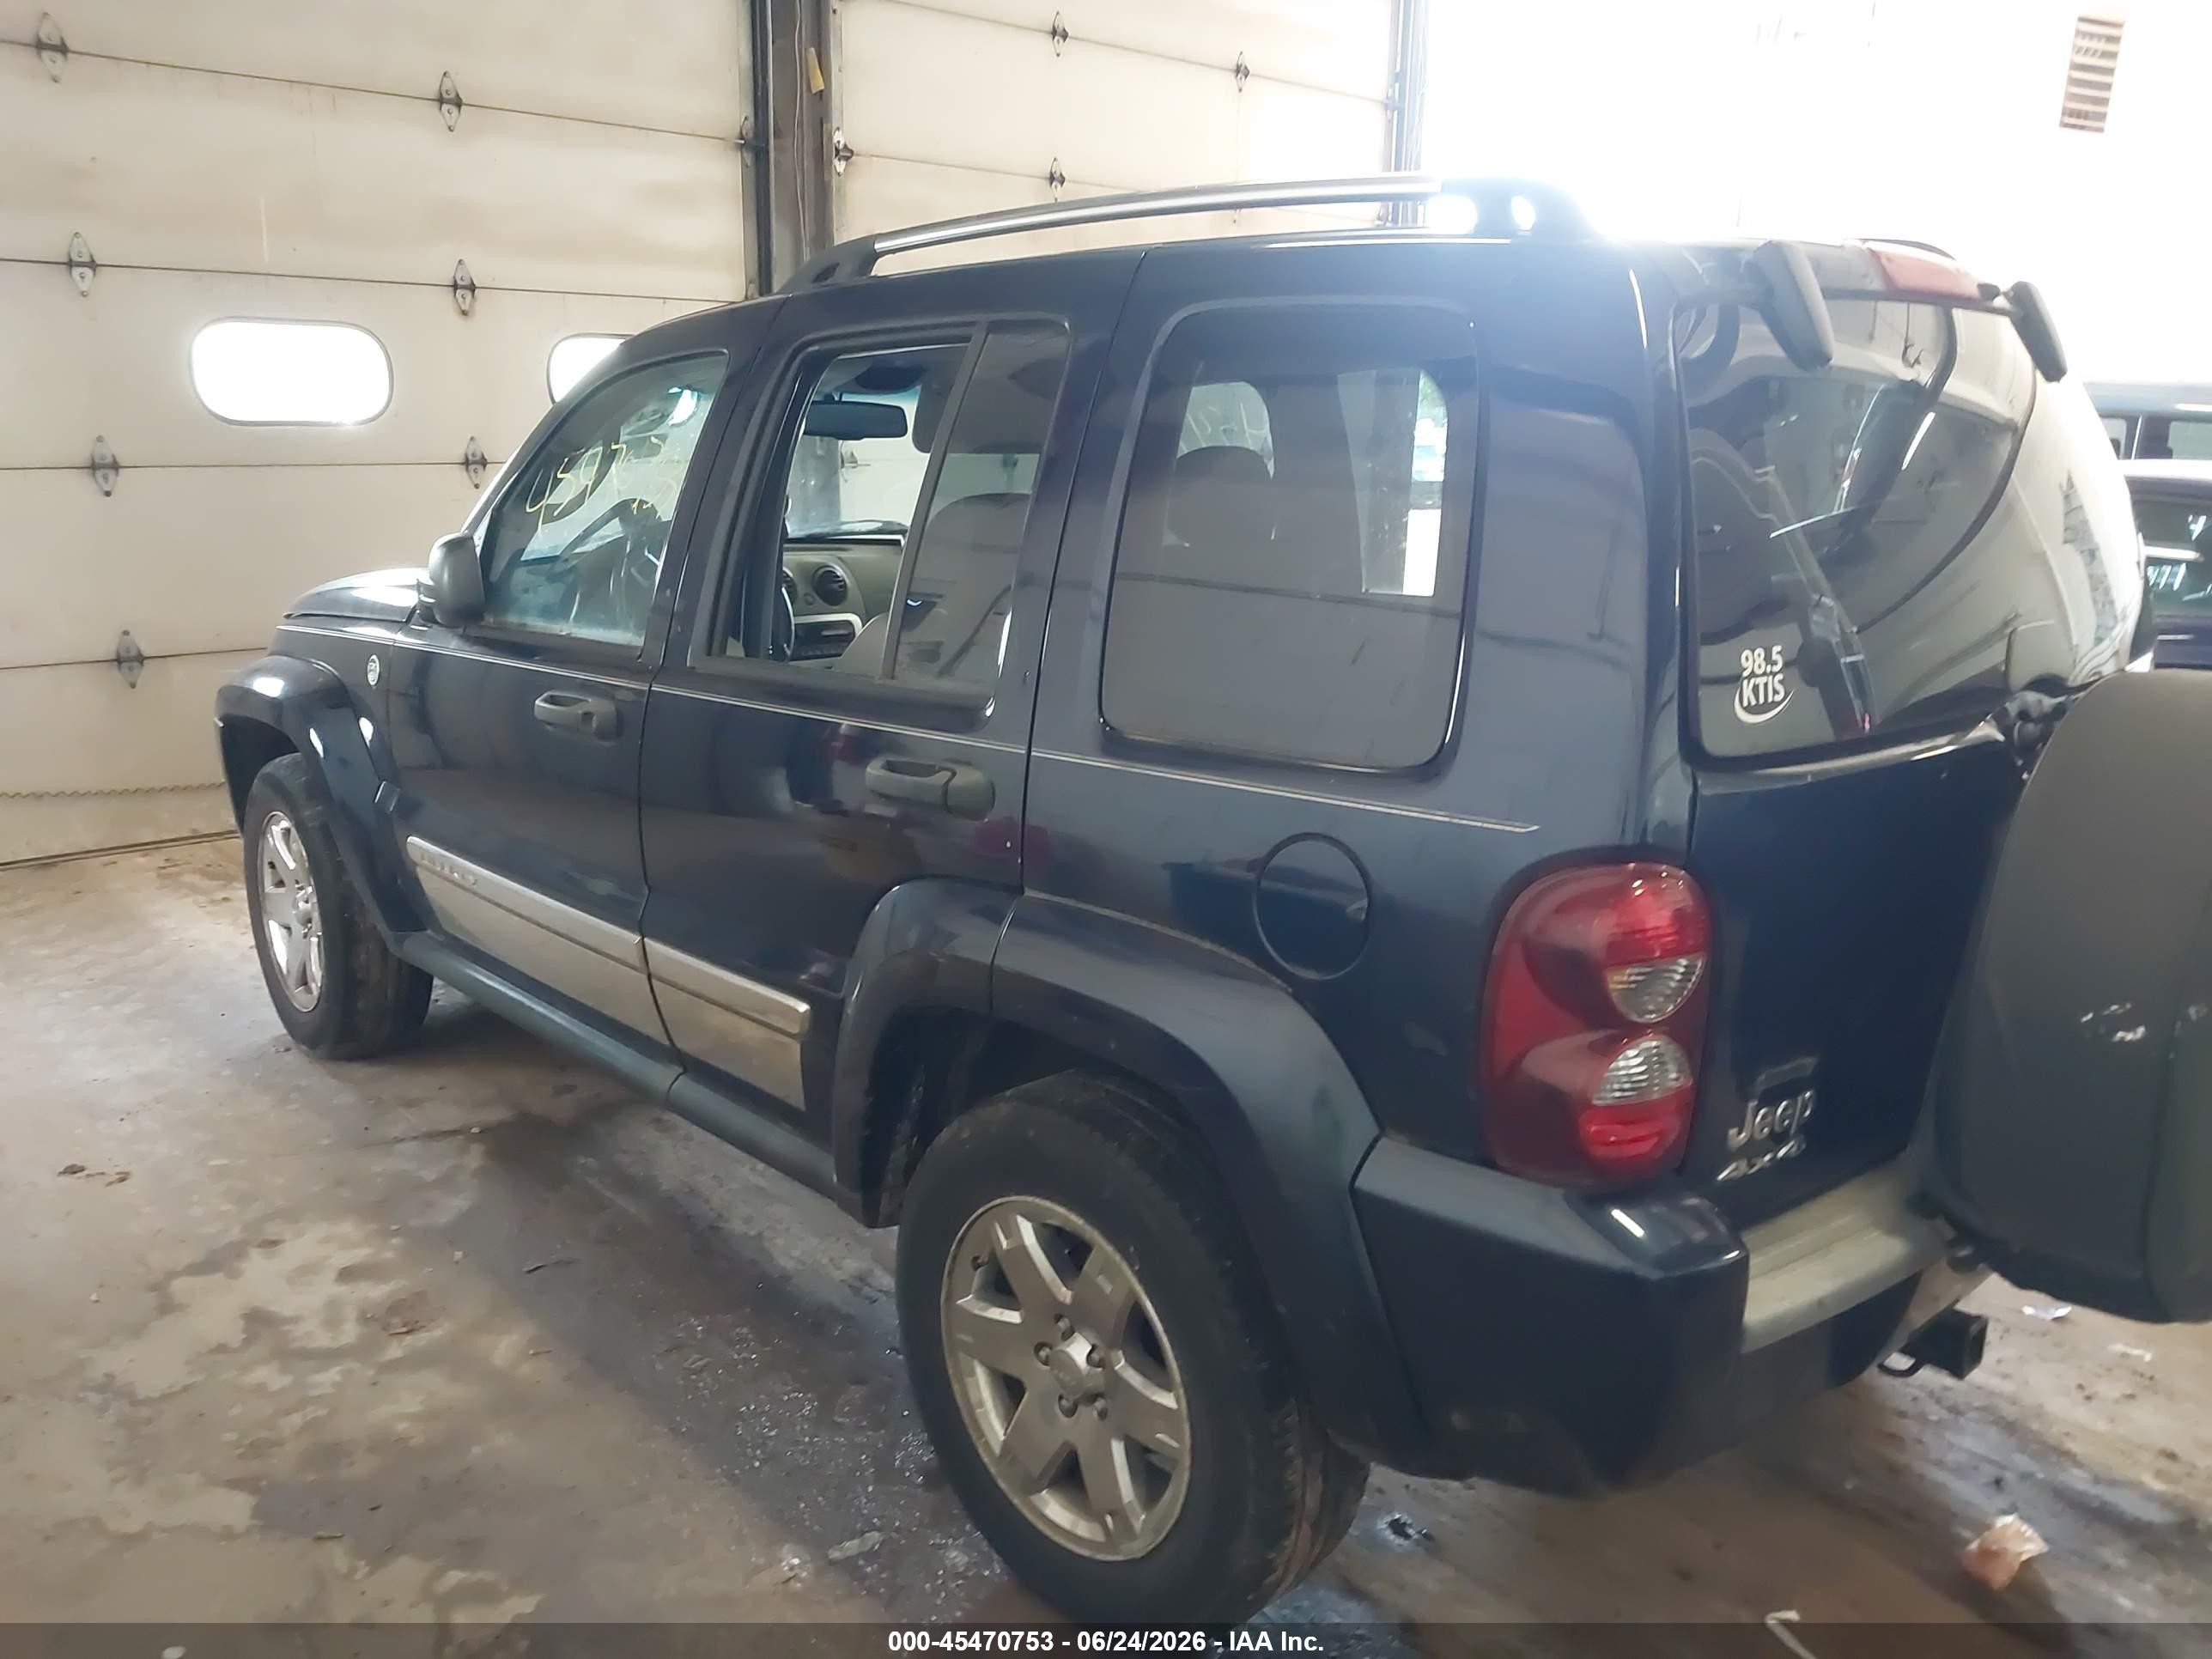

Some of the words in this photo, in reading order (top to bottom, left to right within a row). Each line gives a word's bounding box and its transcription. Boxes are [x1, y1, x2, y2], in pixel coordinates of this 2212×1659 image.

[1740, 644, 1784, 678] 98.5
[1741, 673, 1786, 708] KTIS
[1727, 1091, 1814, 1151] Jeep
